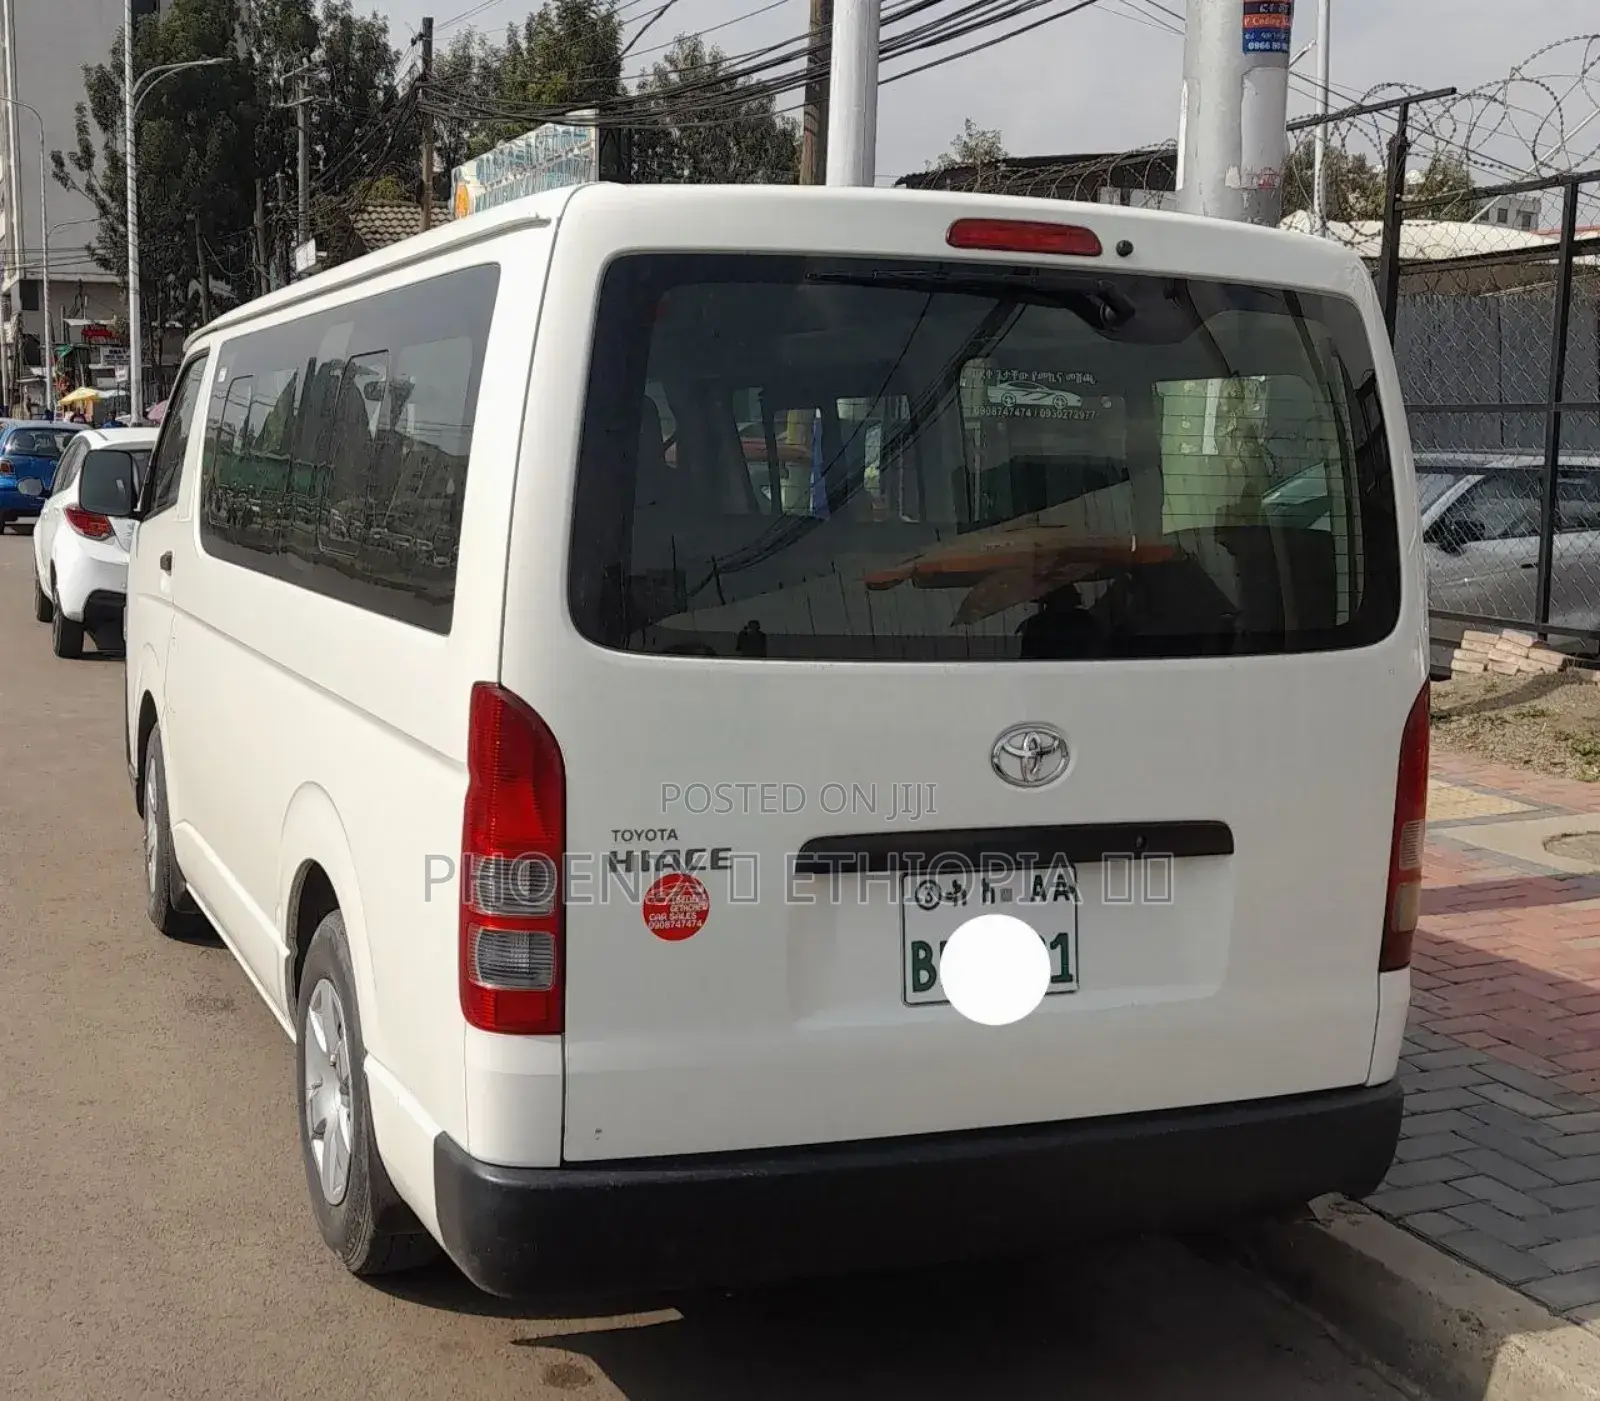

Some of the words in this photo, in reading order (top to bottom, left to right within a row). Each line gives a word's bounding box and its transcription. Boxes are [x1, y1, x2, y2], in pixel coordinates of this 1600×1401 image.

[611, 829, 678, 842] TOYOTA
[609, 848, 732, 872] HIACE
[1030, 874, 1070, 902] AA
